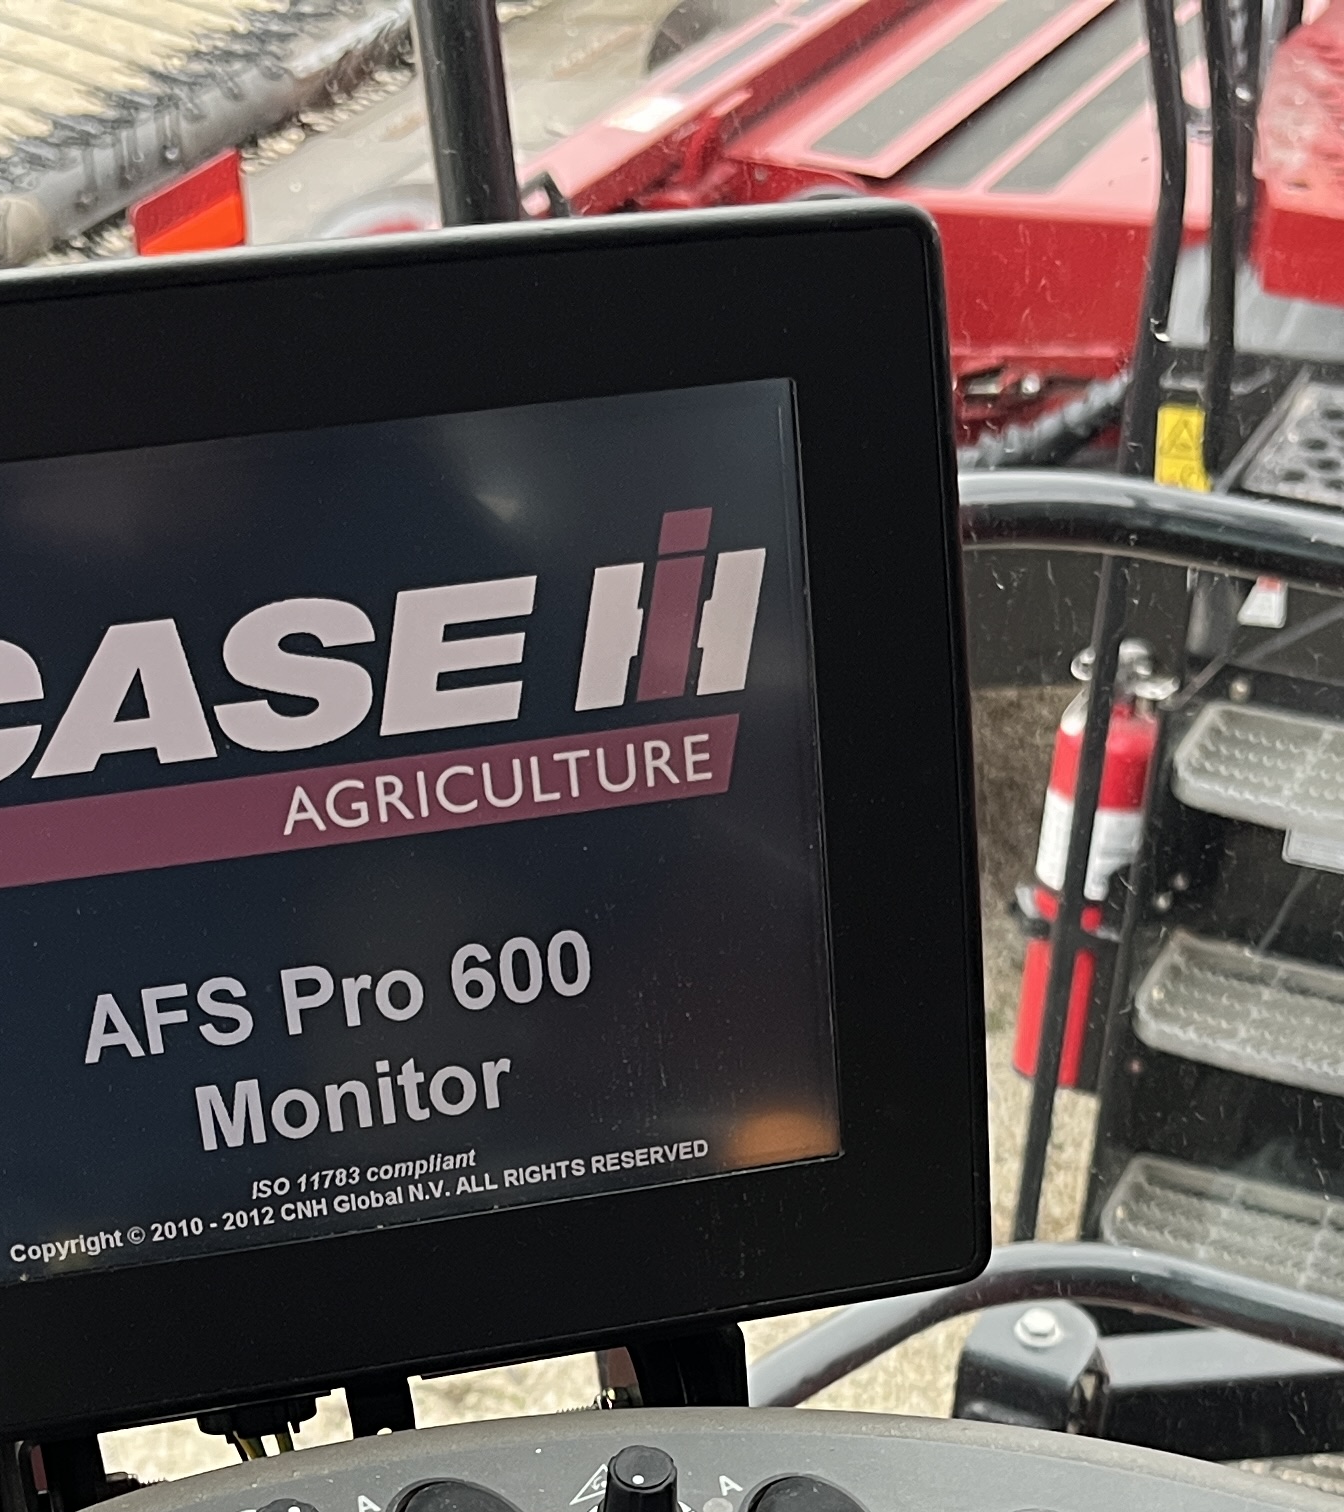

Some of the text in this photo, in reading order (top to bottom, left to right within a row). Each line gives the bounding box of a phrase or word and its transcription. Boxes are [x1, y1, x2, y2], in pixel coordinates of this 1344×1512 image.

[574, 507, 766, 711] IH
[283, 733, 712, 835] AGRICULTURE
[84, 929, 591, 1064] AFS Pro 600
[194, 1057, 511, 1151] Monitor
[9, 1229, 123, 1262] Copyright
[150, 1216, 203, 1241] 2010
[221, 1205, 275, 1230] 2012
[280, 1197, 327, 1221] CNH
[332, 1185, 403, 1213] Global
[407, 1178, 450, 1202] N.V.
[455, 1172, 498, 1195] ALL
[503, 1158, 585, 1187] RIGHTS
[590, 1138, 708, 1173] RESERVED
[251, 1148, 476, 1200] ISO 11783 compliant
[719, 1475, 743, 1496] A
